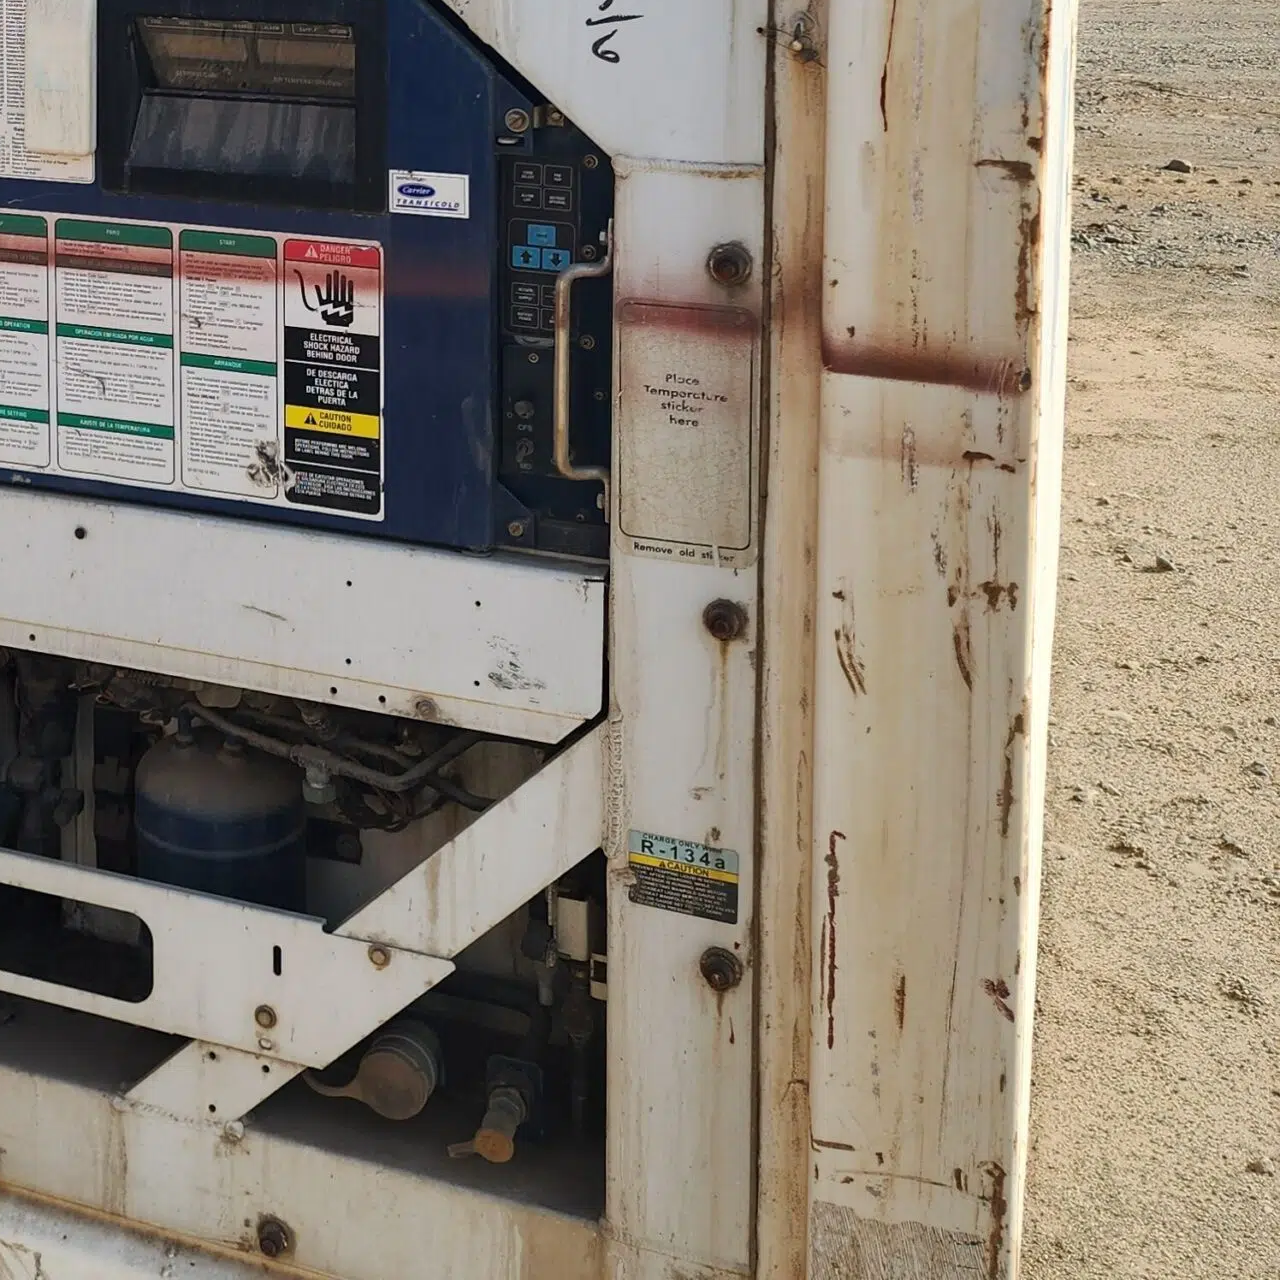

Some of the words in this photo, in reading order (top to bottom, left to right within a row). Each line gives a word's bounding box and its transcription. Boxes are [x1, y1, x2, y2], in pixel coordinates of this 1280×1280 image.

[592, 29, 620, 64] 6
[402, 186, 431, 195] Carrier
[397, 198, 460, 209] TRANSICOLD
[320, 244, 351, 255] DANGER
[320, 253, 351, 264] PELIGRO
[310, 333, 354, 345] ELECTRICAL
[303, 341, 329, 351] SHOCK
[330, 344, 360, 355] HAZARD
[306, 350, 334, 360] BEHIND
[336, 353, 357, 363] DOOR
[306, 368, 316, 377] DE
[318, 370, 358, 382] DESCARGA
[665, 372, 700, 386] Place
[314, 378, 349, 389] ELECTICA
[306, 386, 335, 397] DETRAS
[336, 390, 347, 398] DE
[348, 391, 358, 399] LA
[317, 395, 346, 406] PUERTA
[661, 401, 704, 413] sticker
[319, 412, 352, 423] CAUTION
[669, 415, 699, 427] here
[319, 420, 352, 431] CUIDADO
[633, 542, 673, 555] Remove
[679, 546, 696, 558] old
[642, 833, 676, 845] CHARGE
[679, 840, 699, 849] ONLY
[641, 839, 726, 869] R-134a
[666, 862, 709, 877] CAUTION
